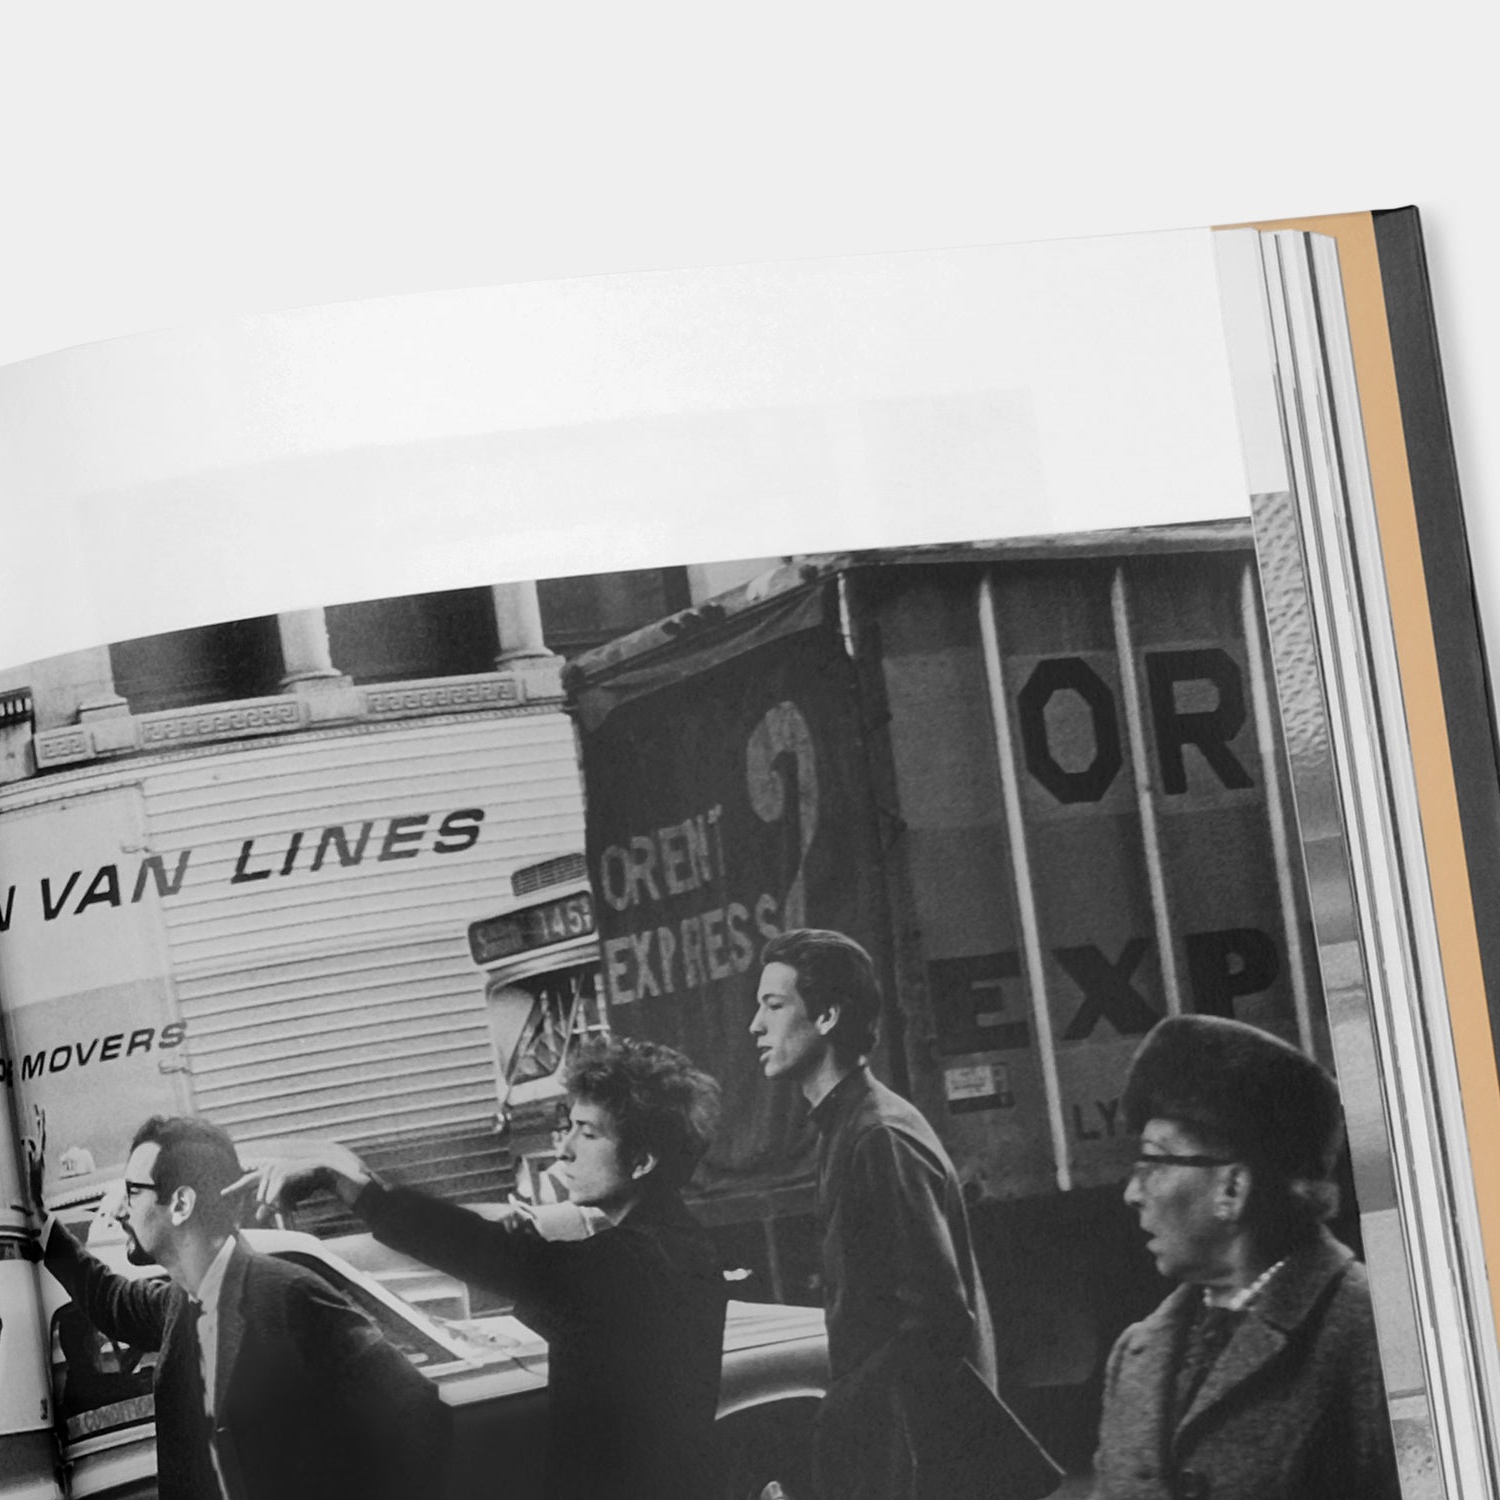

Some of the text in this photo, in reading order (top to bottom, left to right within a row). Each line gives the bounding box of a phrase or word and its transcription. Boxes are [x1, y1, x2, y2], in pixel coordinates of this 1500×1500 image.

[40, 850, 192, 922] VAN
[230, 808, 486, 885] LINES
[21, 1021, 187, 1081] MOVERS
